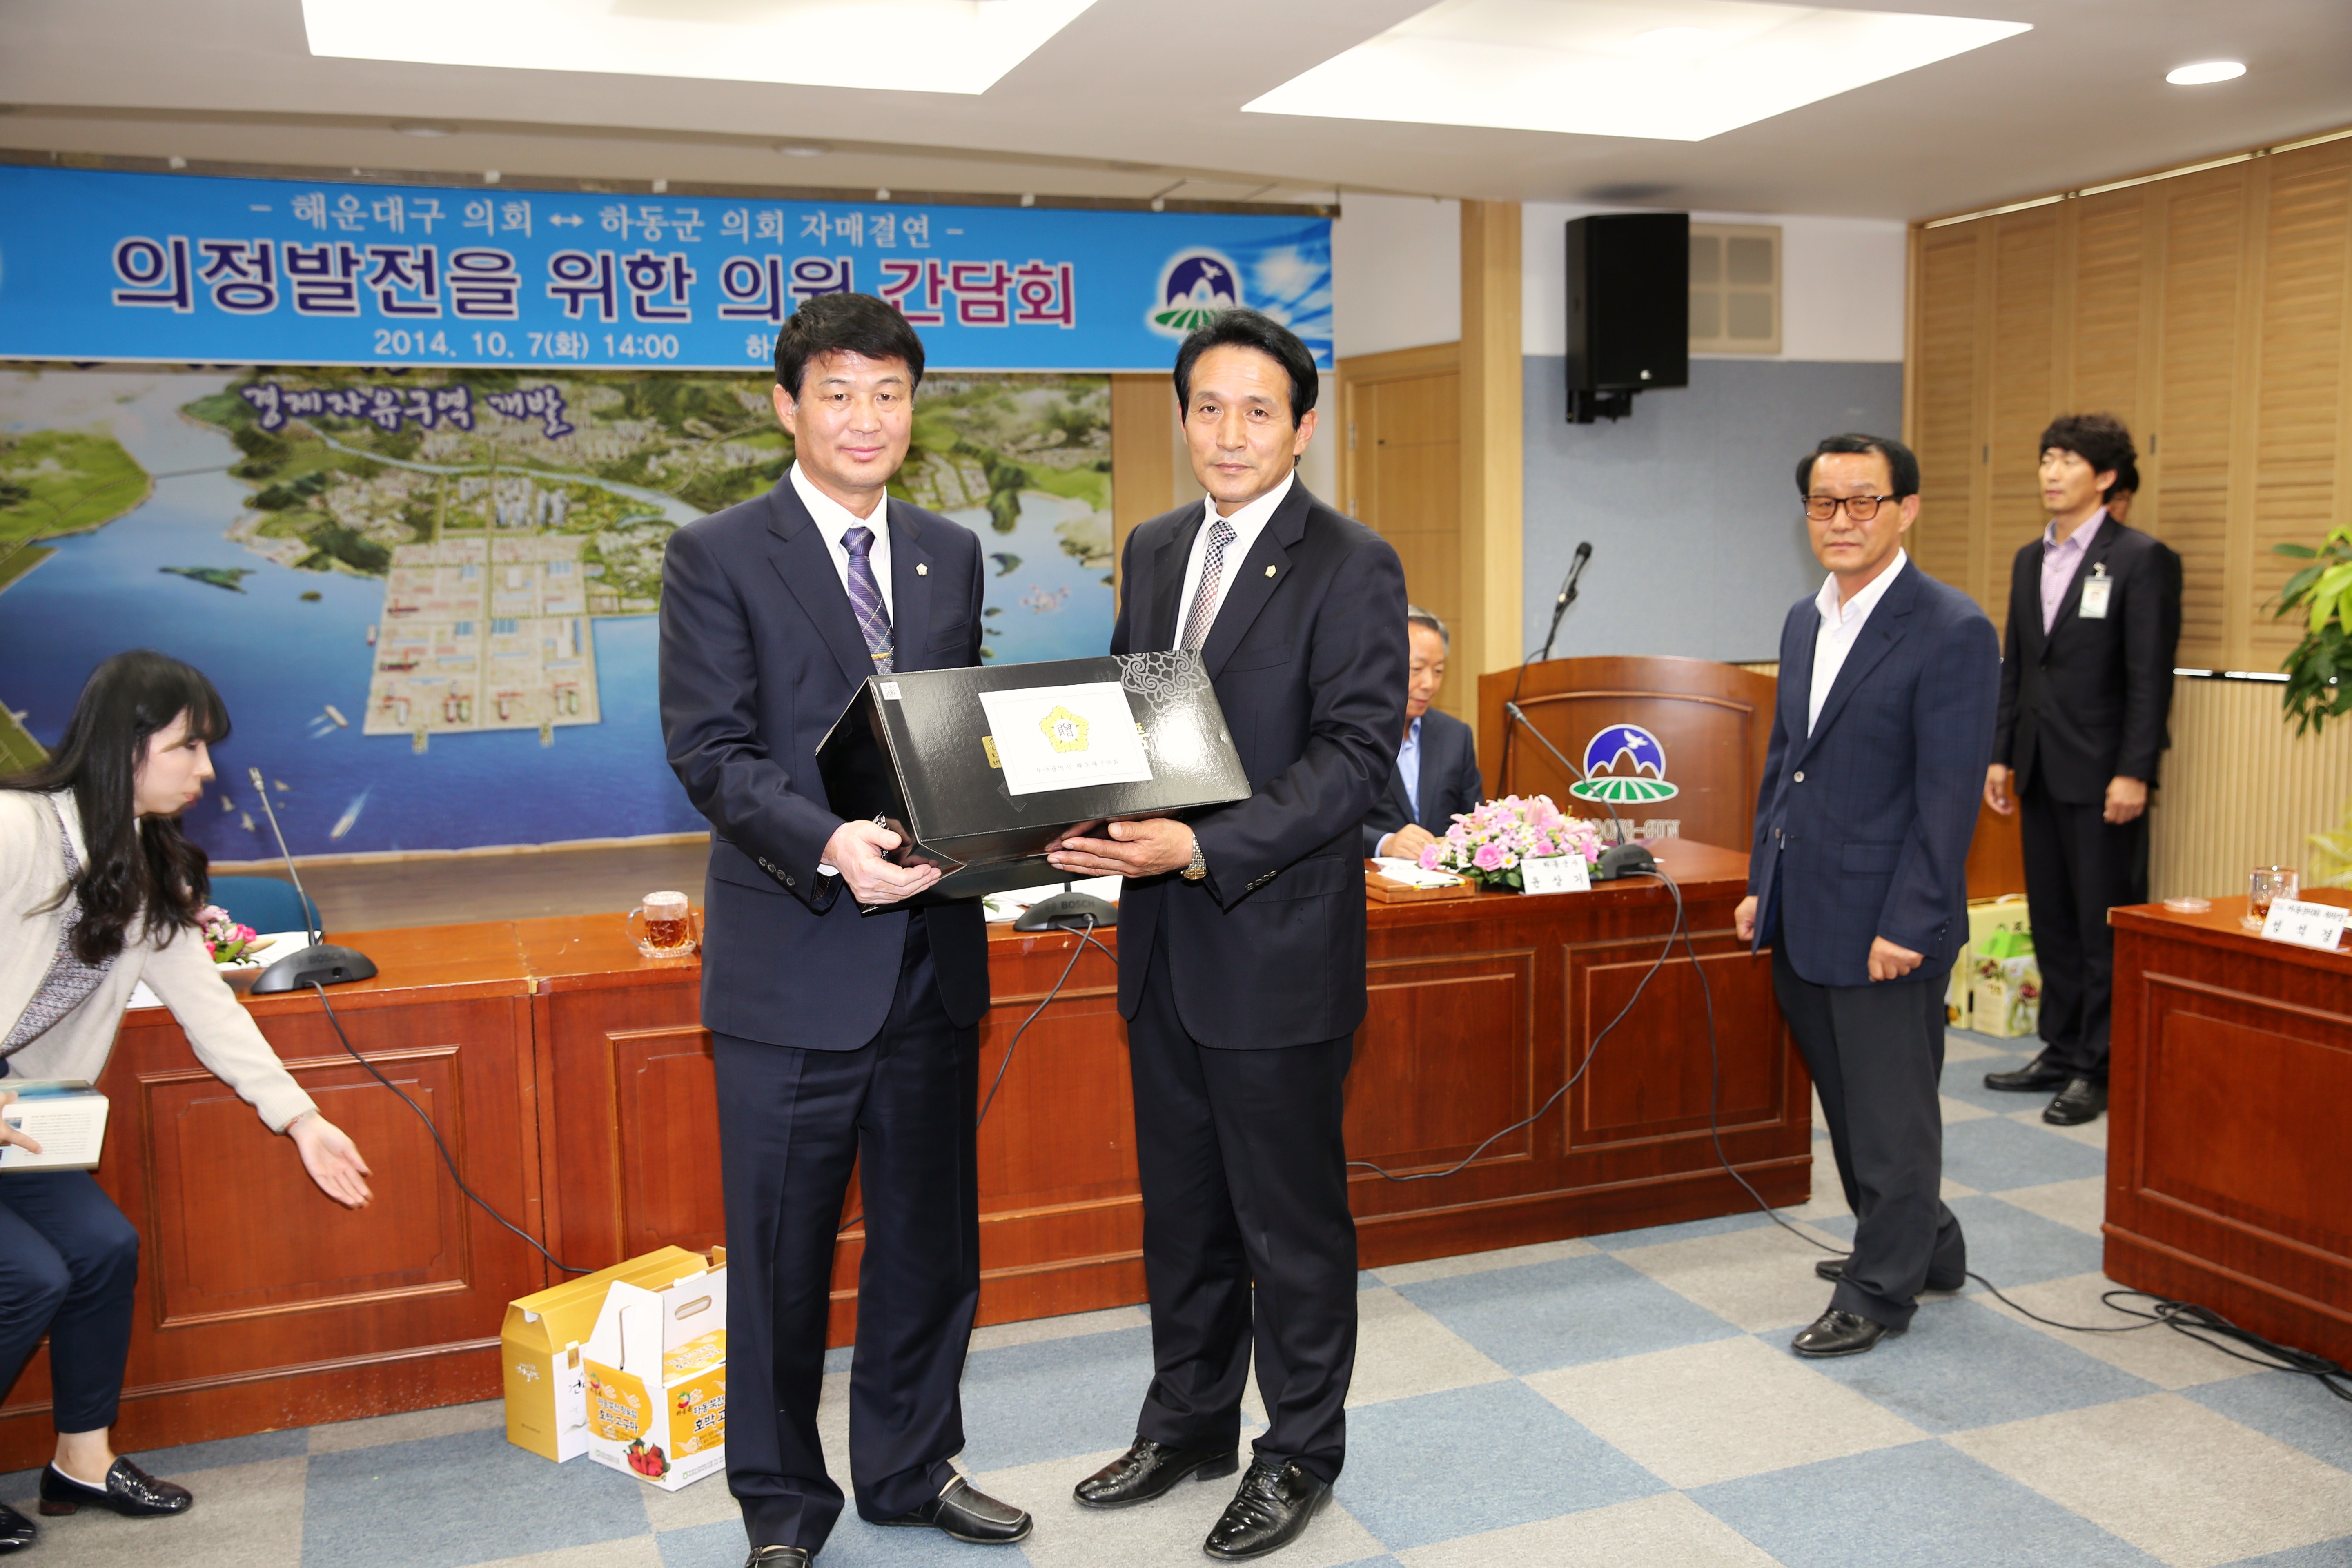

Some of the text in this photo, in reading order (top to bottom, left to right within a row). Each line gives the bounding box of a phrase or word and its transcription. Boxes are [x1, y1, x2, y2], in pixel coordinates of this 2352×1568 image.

[291, 192, 446, 235] 해운대구
[462, 198, 532, 238] 의회
[598, 203, 705, 242] 하동군
[720, 207, 784, 245] 의회
[800, 209, 931, 248] 자매결연
[112, 234, 521, 320] 의정발전을
[546, 249, 697, 323] 위한
[878, 258, 1076, 329] 간담회
[374, 329, 779, 362] 2014. 10. 7(화) 14:00 하
[240, 381, 575, 439] 경제자유구역 개발
[1061, 900, 1095, 909] BOSCH
[308, 952, 346, 964] BOSCH
[693, 1413, 716, 1433] 호박
